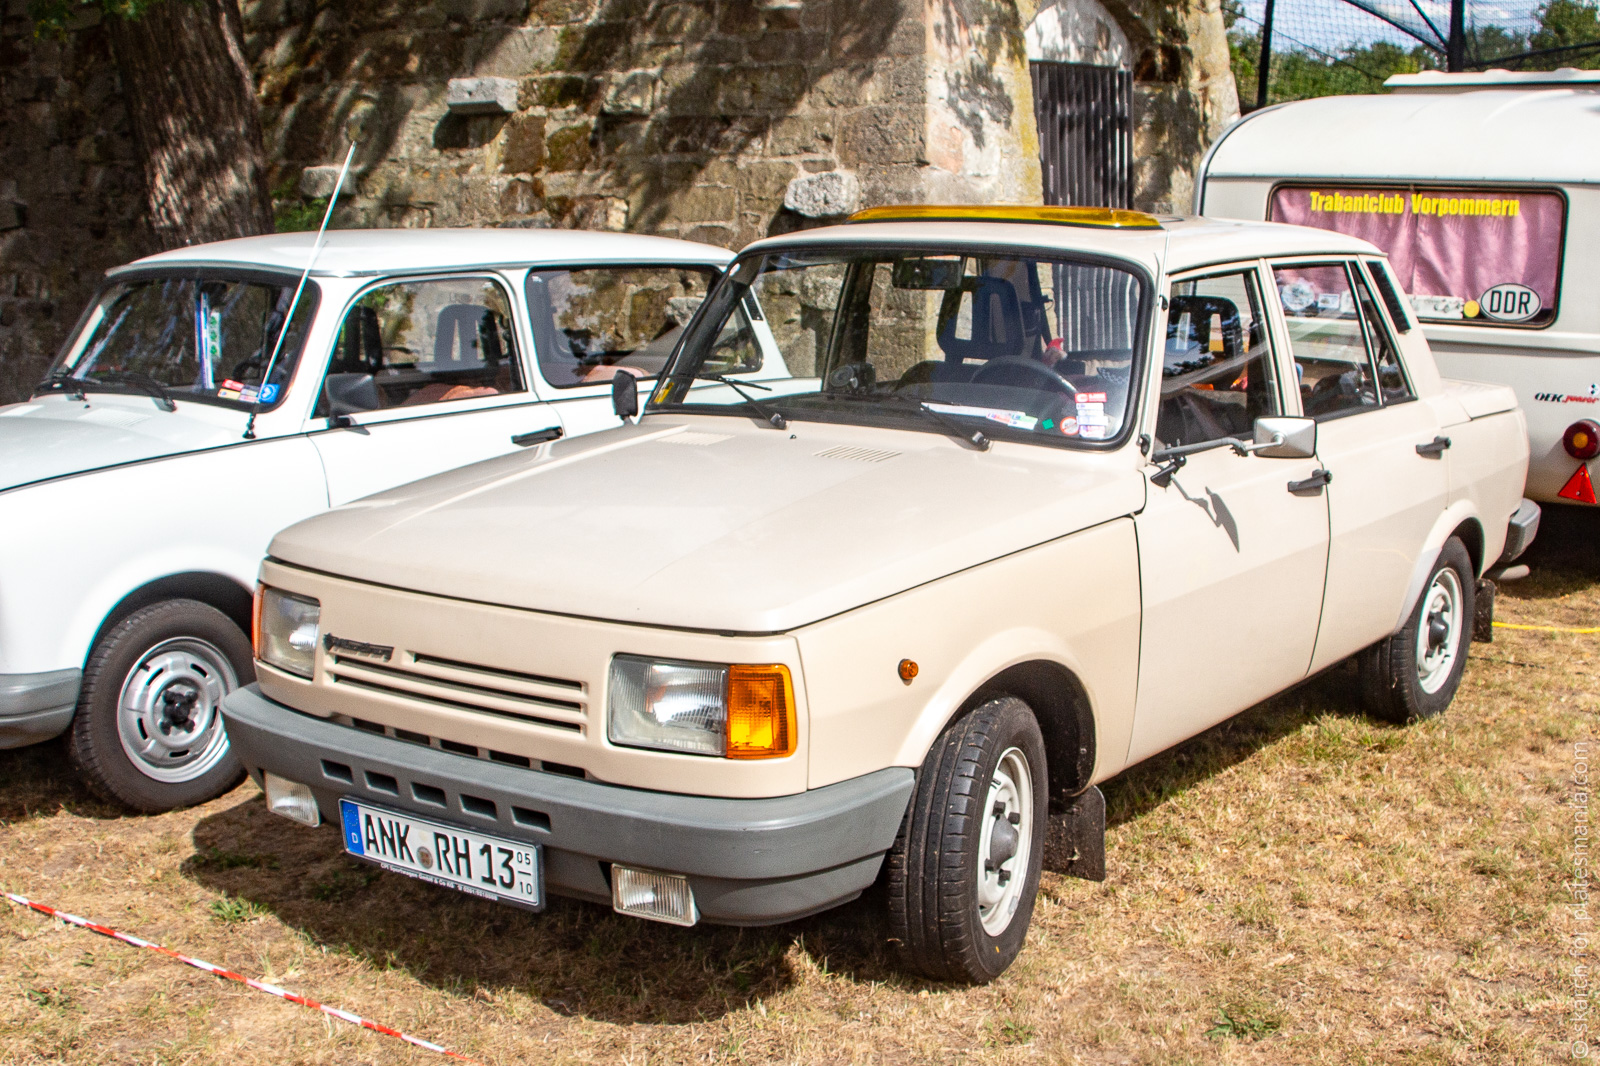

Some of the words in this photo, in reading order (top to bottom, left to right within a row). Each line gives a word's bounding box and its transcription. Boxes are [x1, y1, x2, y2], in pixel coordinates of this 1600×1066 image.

[1310, 192, 1404, 214] Trabantclub
[1411, 194, 1520, 217] Vorpommern
[1489, 290, 1530, 316] DDR
[351, 832, 359, 844] D
[365, 814, 415, 863] ANK
[433, 832, 473, 879] RH
[479, 843, 515, 889] 13
[517, 852, 531, 865] 05
[519, 881, 533, 895] 10
